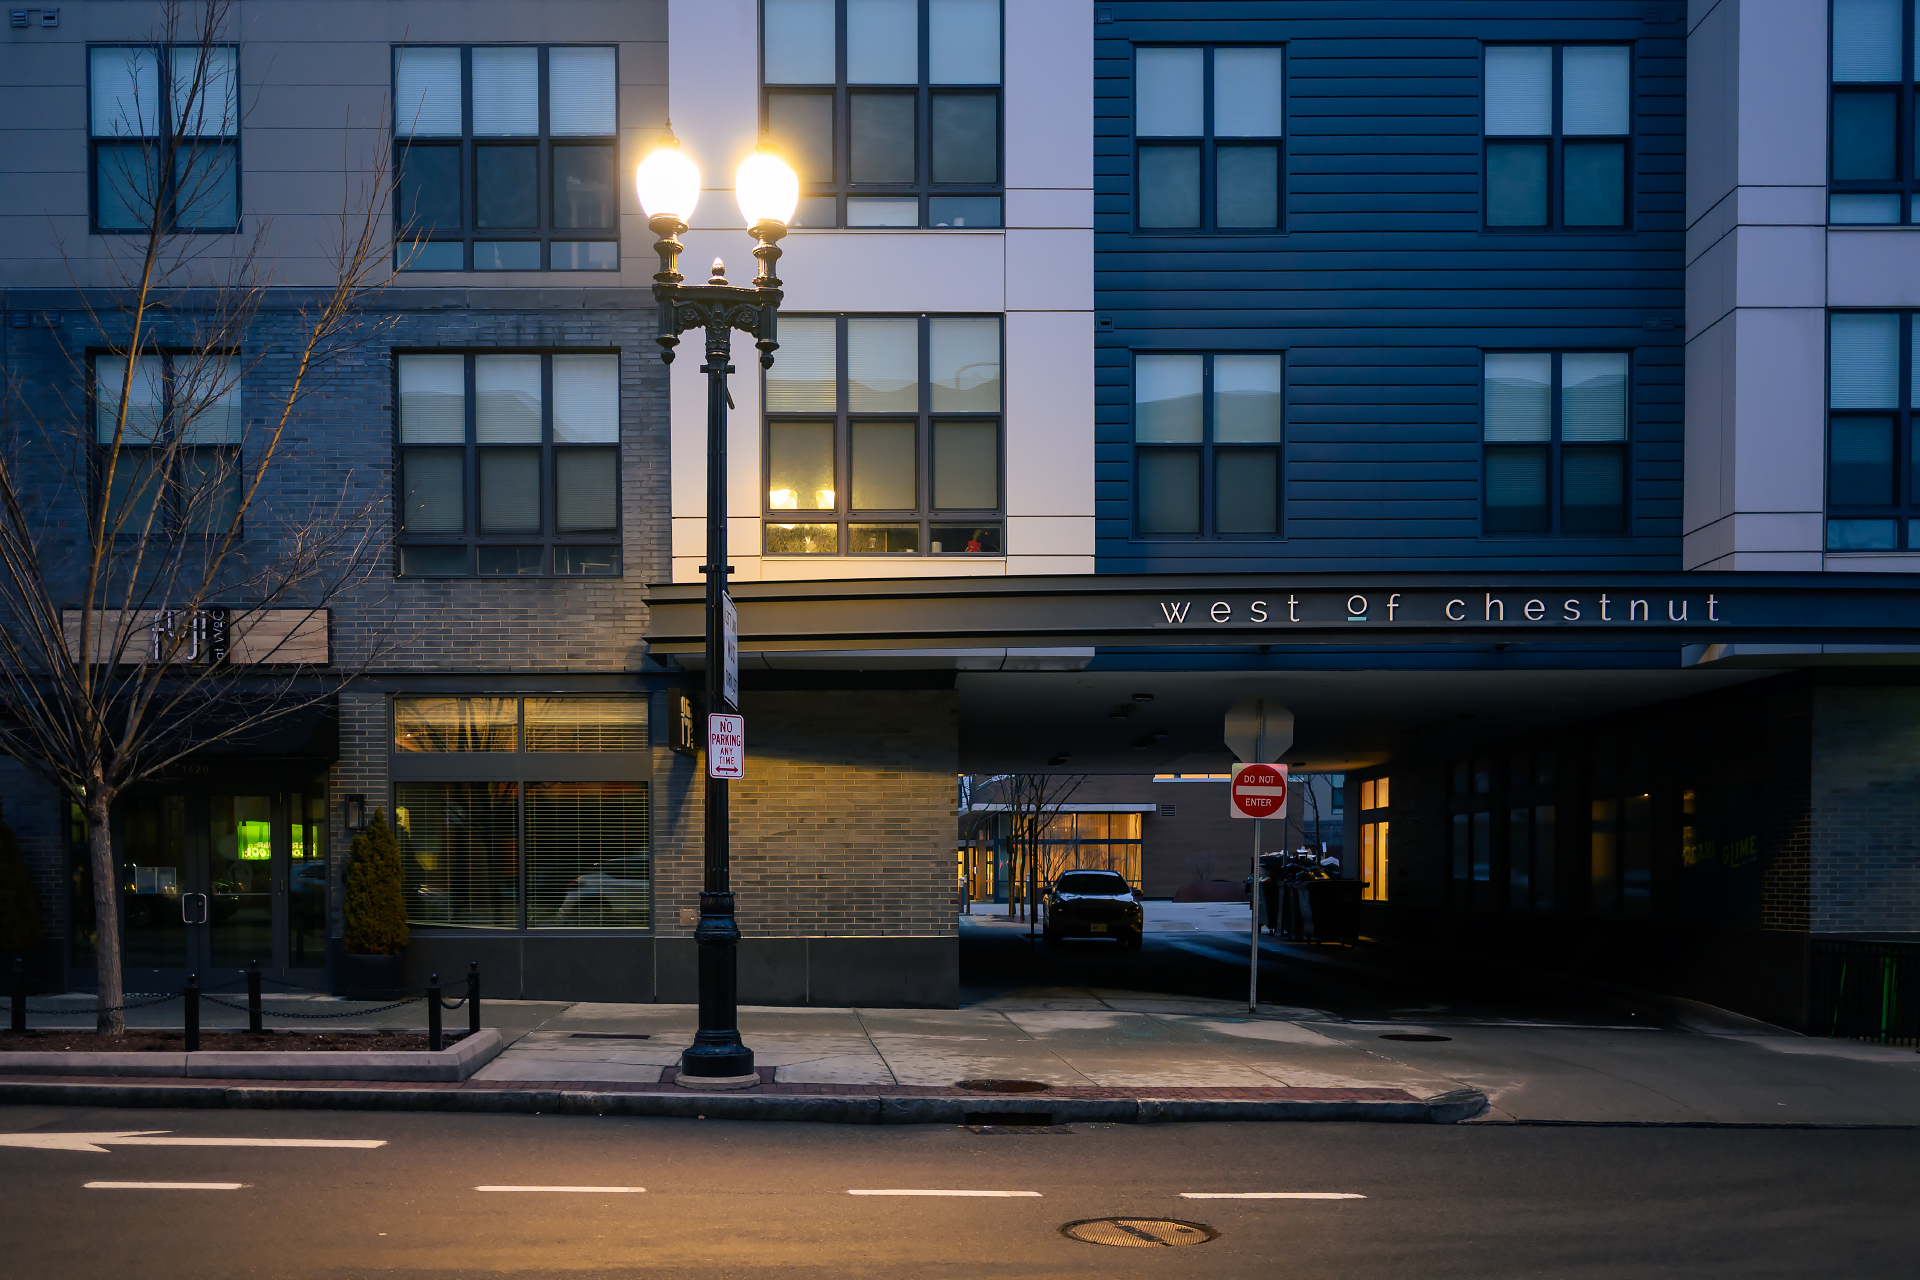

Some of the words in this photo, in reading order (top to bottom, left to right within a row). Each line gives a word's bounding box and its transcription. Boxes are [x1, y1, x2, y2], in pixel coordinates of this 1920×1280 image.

[1161, 594, 1300, 623] west
[1347, 593, 1400, 621] of
[1445, 593, 1719, 622] chestnut
[720, 721, 733, 734] NO
[711, 733, 741, 747] PARKING
[719, 747, 733, 756] ANY
[718, 756, 735, 765] TIME
[181, 765, 209, 774] 1420
[1243, 775, 1256, 784] DO
[1258, 775, 1275, 784] NOT
[1245, 798, 1272, 807] ENTER
